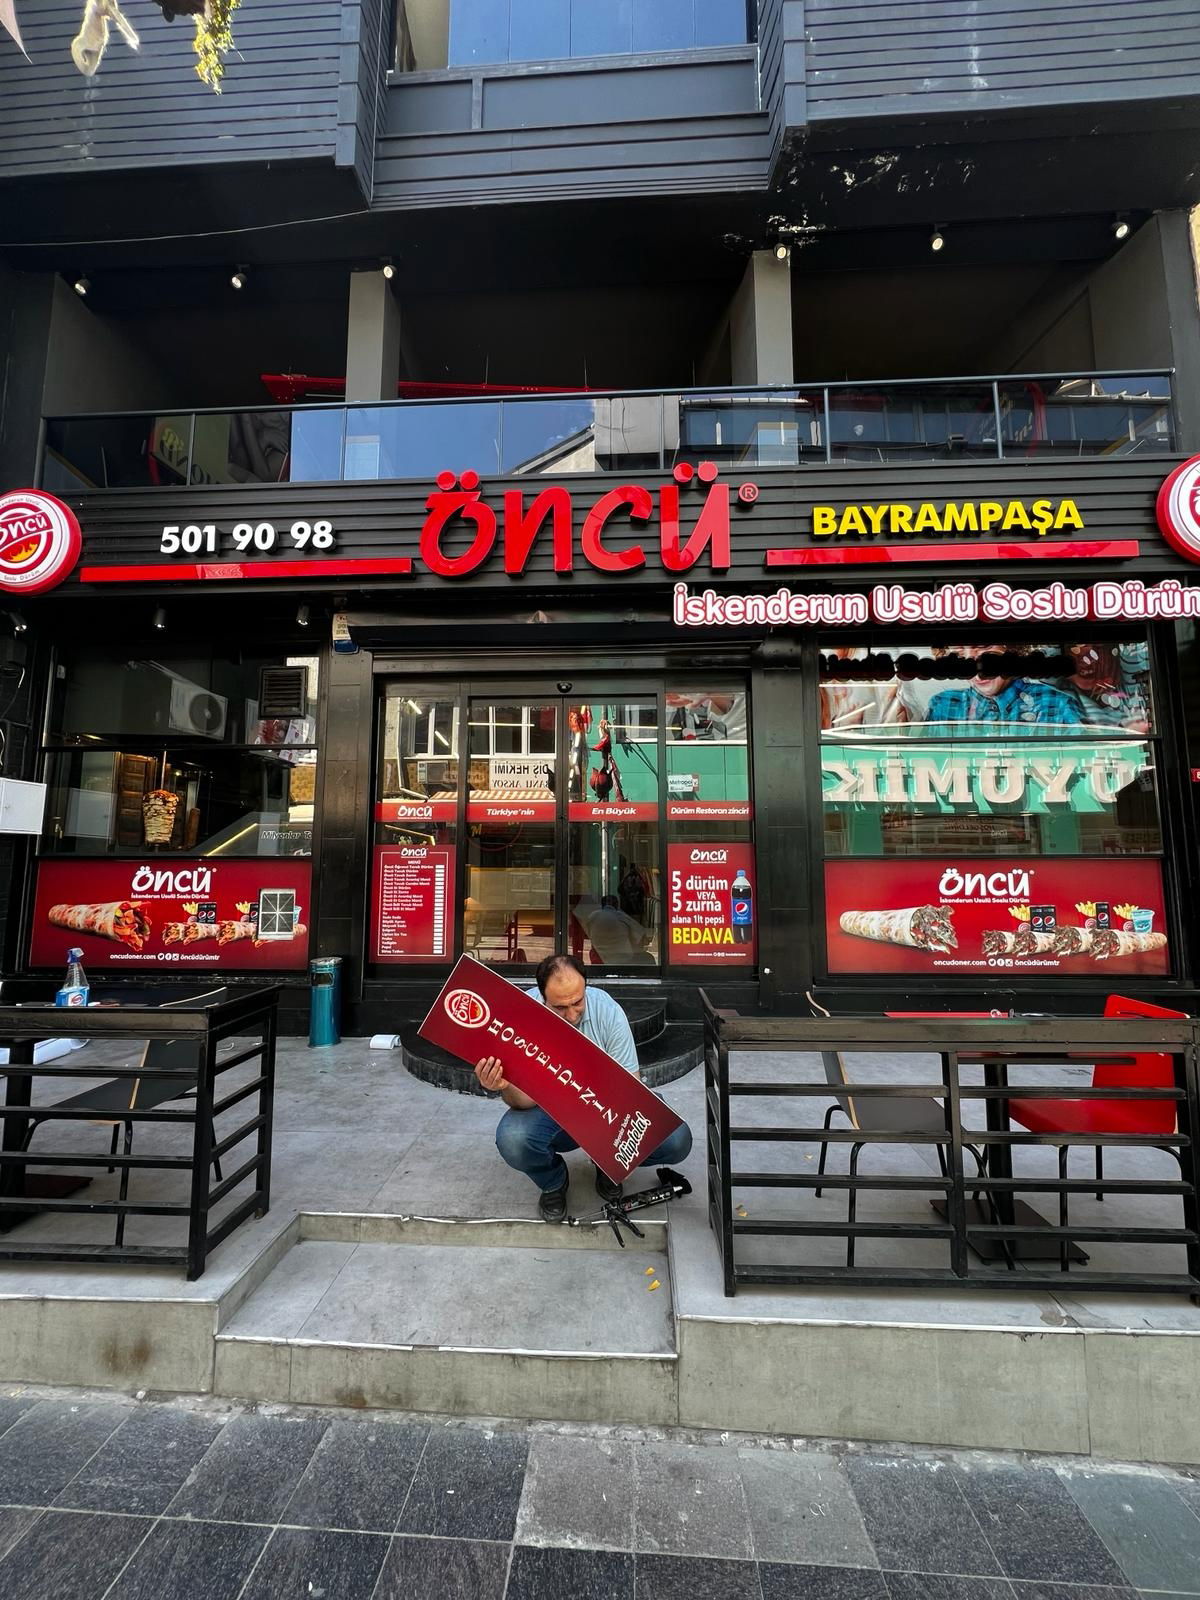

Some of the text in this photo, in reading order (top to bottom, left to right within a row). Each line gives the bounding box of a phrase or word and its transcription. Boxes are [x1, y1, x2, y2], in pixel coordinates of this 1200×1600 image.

[812, 500, 1084, 535] BAYRAMPAŞA
[160, 521, 334, 553] 501 90 98
[674, 582, 869, 625] İskenderun
[873, 585, 978, 621] Usulü
[983, 582, 1088, 620] Soslu
[486, 808, 535, 816] Türkiye'nin
[672, 871, 728, 890] 5 dürüm
[672, 892, 722, 912] 5 zurna
[697, 891, 716, 900] VEYA
[672, 915, 691, 924] alana
[705, 915, 724, 926] pepsi
[673, 927, 735, 944] BEDAVA
